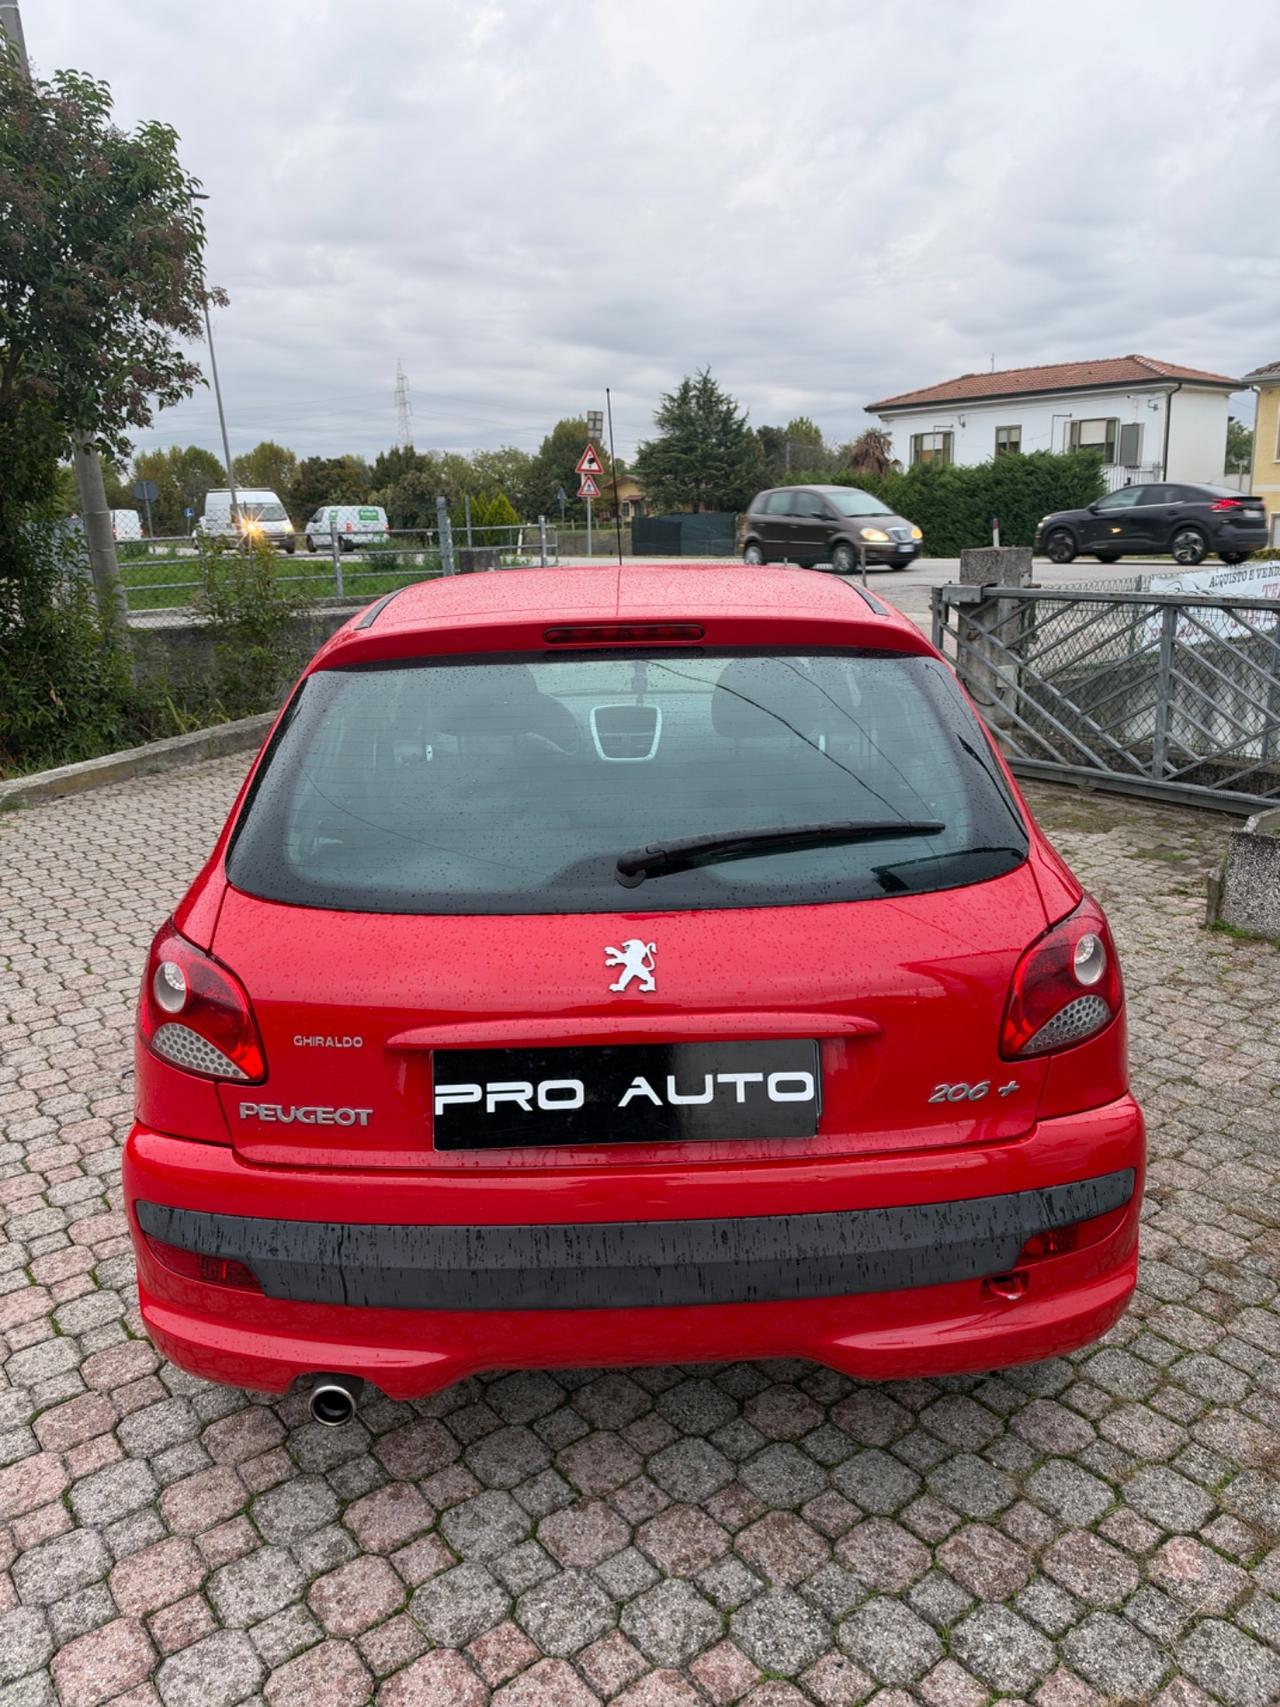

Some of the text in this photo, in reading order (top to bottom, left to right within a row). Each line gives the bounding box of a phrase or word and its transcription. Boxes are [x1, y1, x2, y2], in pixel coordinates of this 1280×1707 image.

[1208, 570, 1248, 588] ACQUISTO
[1248, 569, 1255, 581] E
[293, 1035, 363, 1048] GHIRALDO
[434, 1071, 815, 1116] PRO AUTO
[927, 1080, 992, 1103] 206
[239, 1102, 374, 1126] PEUGEOT
